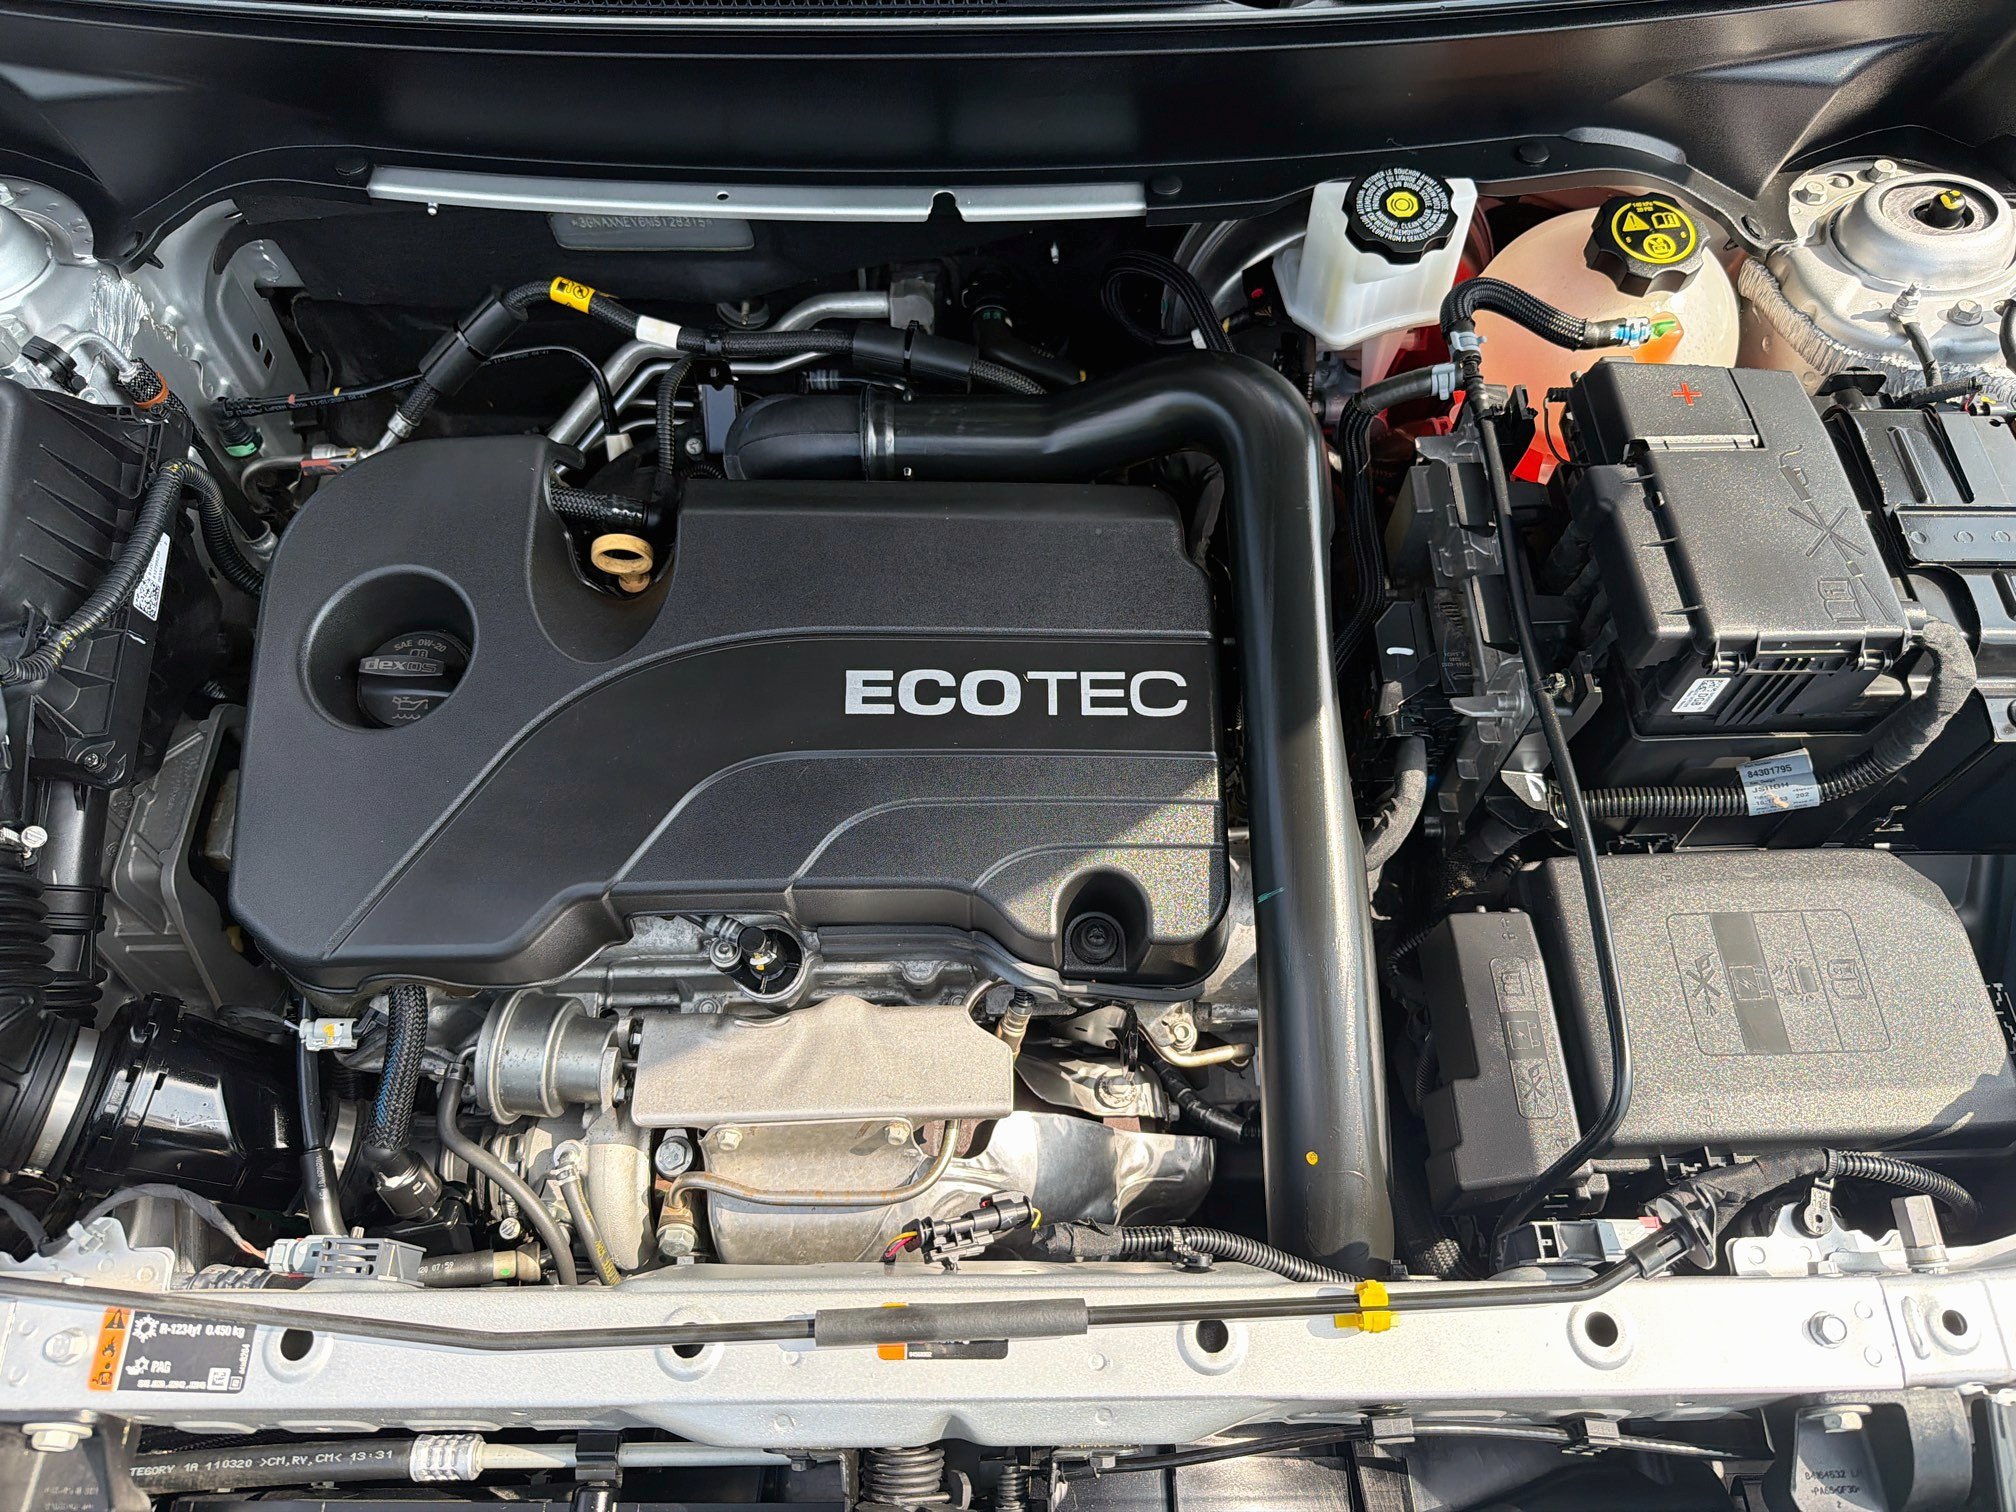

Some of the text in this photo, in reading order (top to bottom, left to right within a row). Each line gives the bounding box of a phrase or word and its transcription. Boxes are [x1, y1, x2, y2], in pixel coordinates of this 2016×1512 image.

[1394, 168, 1421, 178] BOUCHON
[1420, 174, 1437, 186] AVANT
[1374, 220, 1394, 234] BEFORE
[1401, 221, 1420, 230] CLEAN
[1369, 225, 1386, 238] FLUID
[1384, 234, 1402, 242] FROM
[1406, 233, 1428, 242] SEALED
[394, 638, 446, 652] SAE 0W-20
[365, 658, 437, 672] dexos
[845, 669, 1188, 717] ECOTEC
[1747, 764, 1792, 778] 84301795
[432, 1261, 454, 1272] 07:59
[160, 1324, 246, 1338] R-1234yf 0.450 kg
[150, 1360, 172, 1374] PAG
[130, 1464, 175, 1476] TEGORY
[184, 1462, 198, 1472] 1A
[206, 1459, 252, 1470] 110320
[350, 1450, 393, 1461] 13:31
